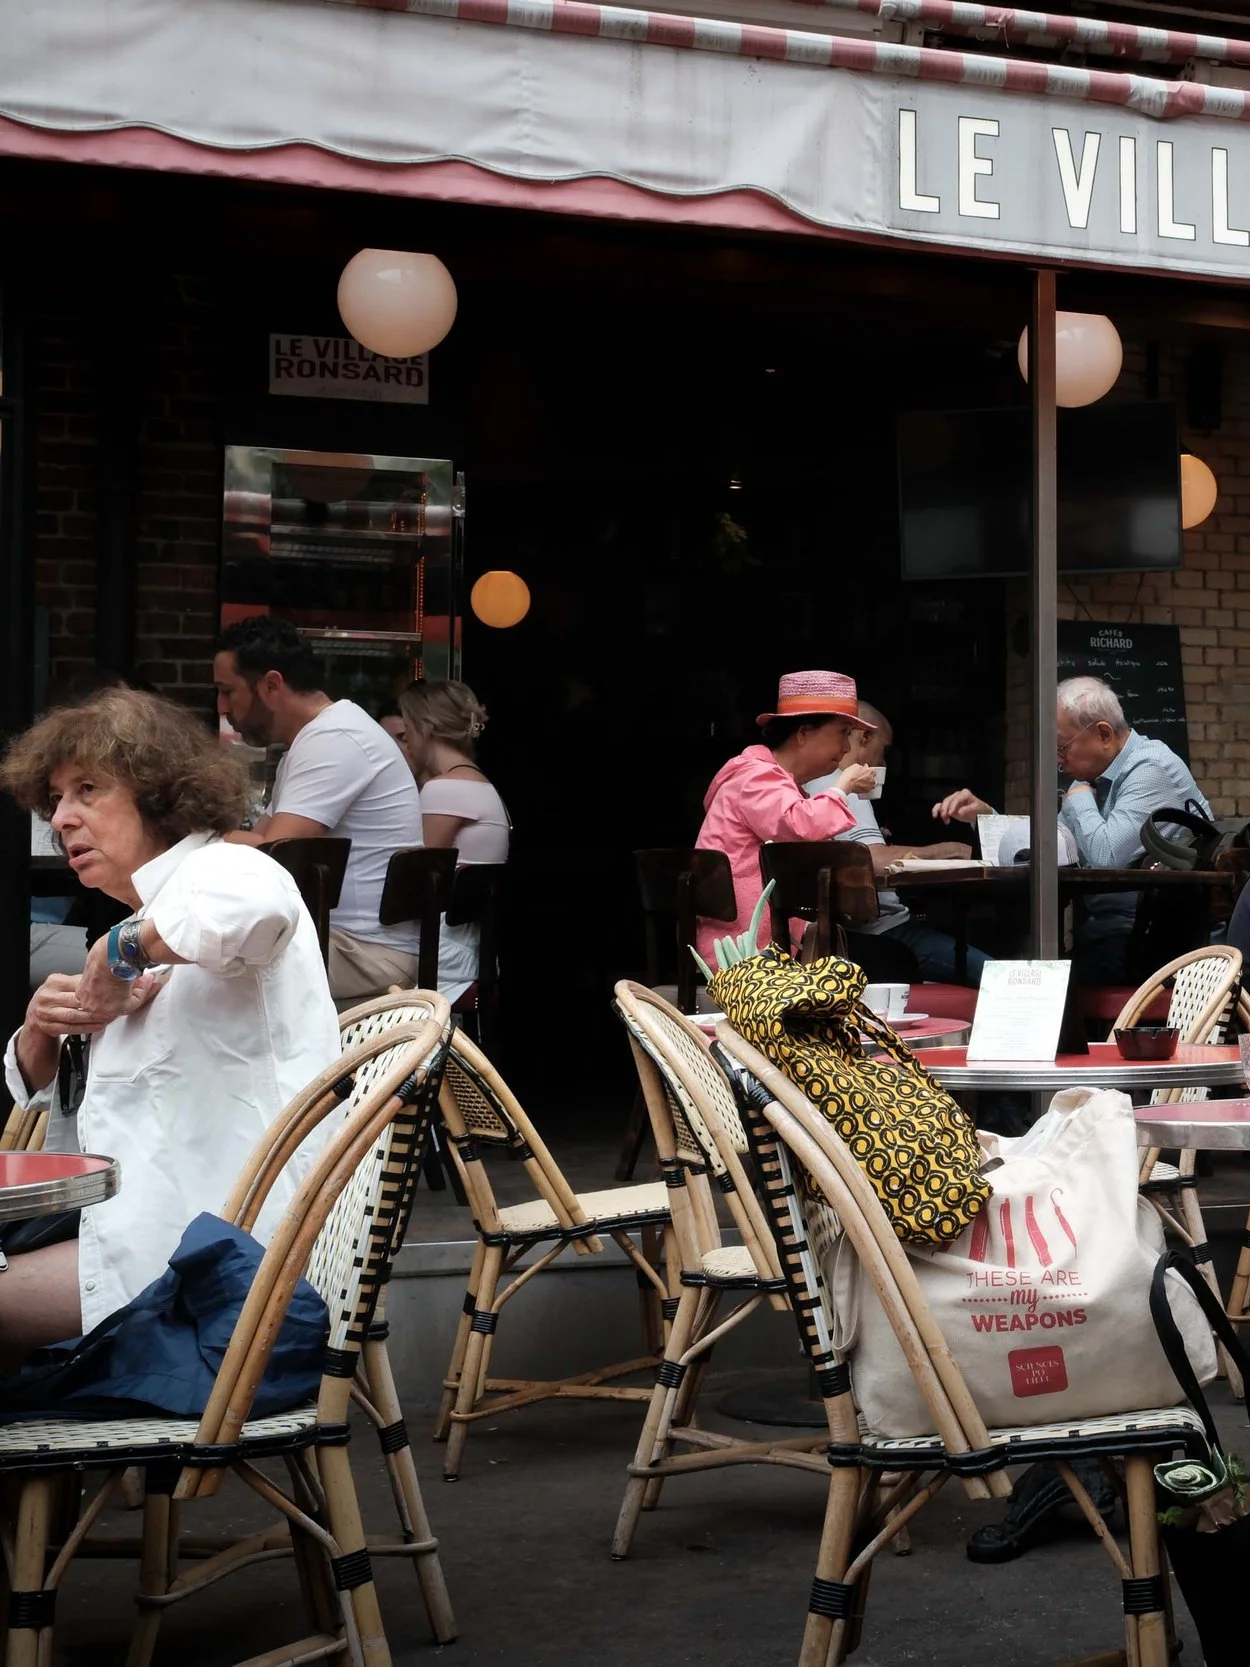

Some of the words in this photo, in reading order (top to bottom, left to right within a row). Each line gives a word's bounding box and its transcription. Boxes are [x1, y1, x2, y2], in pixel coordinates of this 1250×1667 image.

[899, 109, 1000, 219] LE
[275, 339, 303, 357] LE
[275, 358, 424, 387] RONSARD
[1090, 637, 1133, 649] RICHARD
[1007, 977, 1042, 986] RONSARD
[966, 1270, 1032, 1288] THESE
[1040, 1269, 1082, 1286] ARE
[1010, 1288, 1040, 1313] my
[971, 1308, 1088, 1333] WEAPONS
[1015, 1360, 1059, 1371] SCIENCES
[1032, 1369, 1045, 1377] PO
